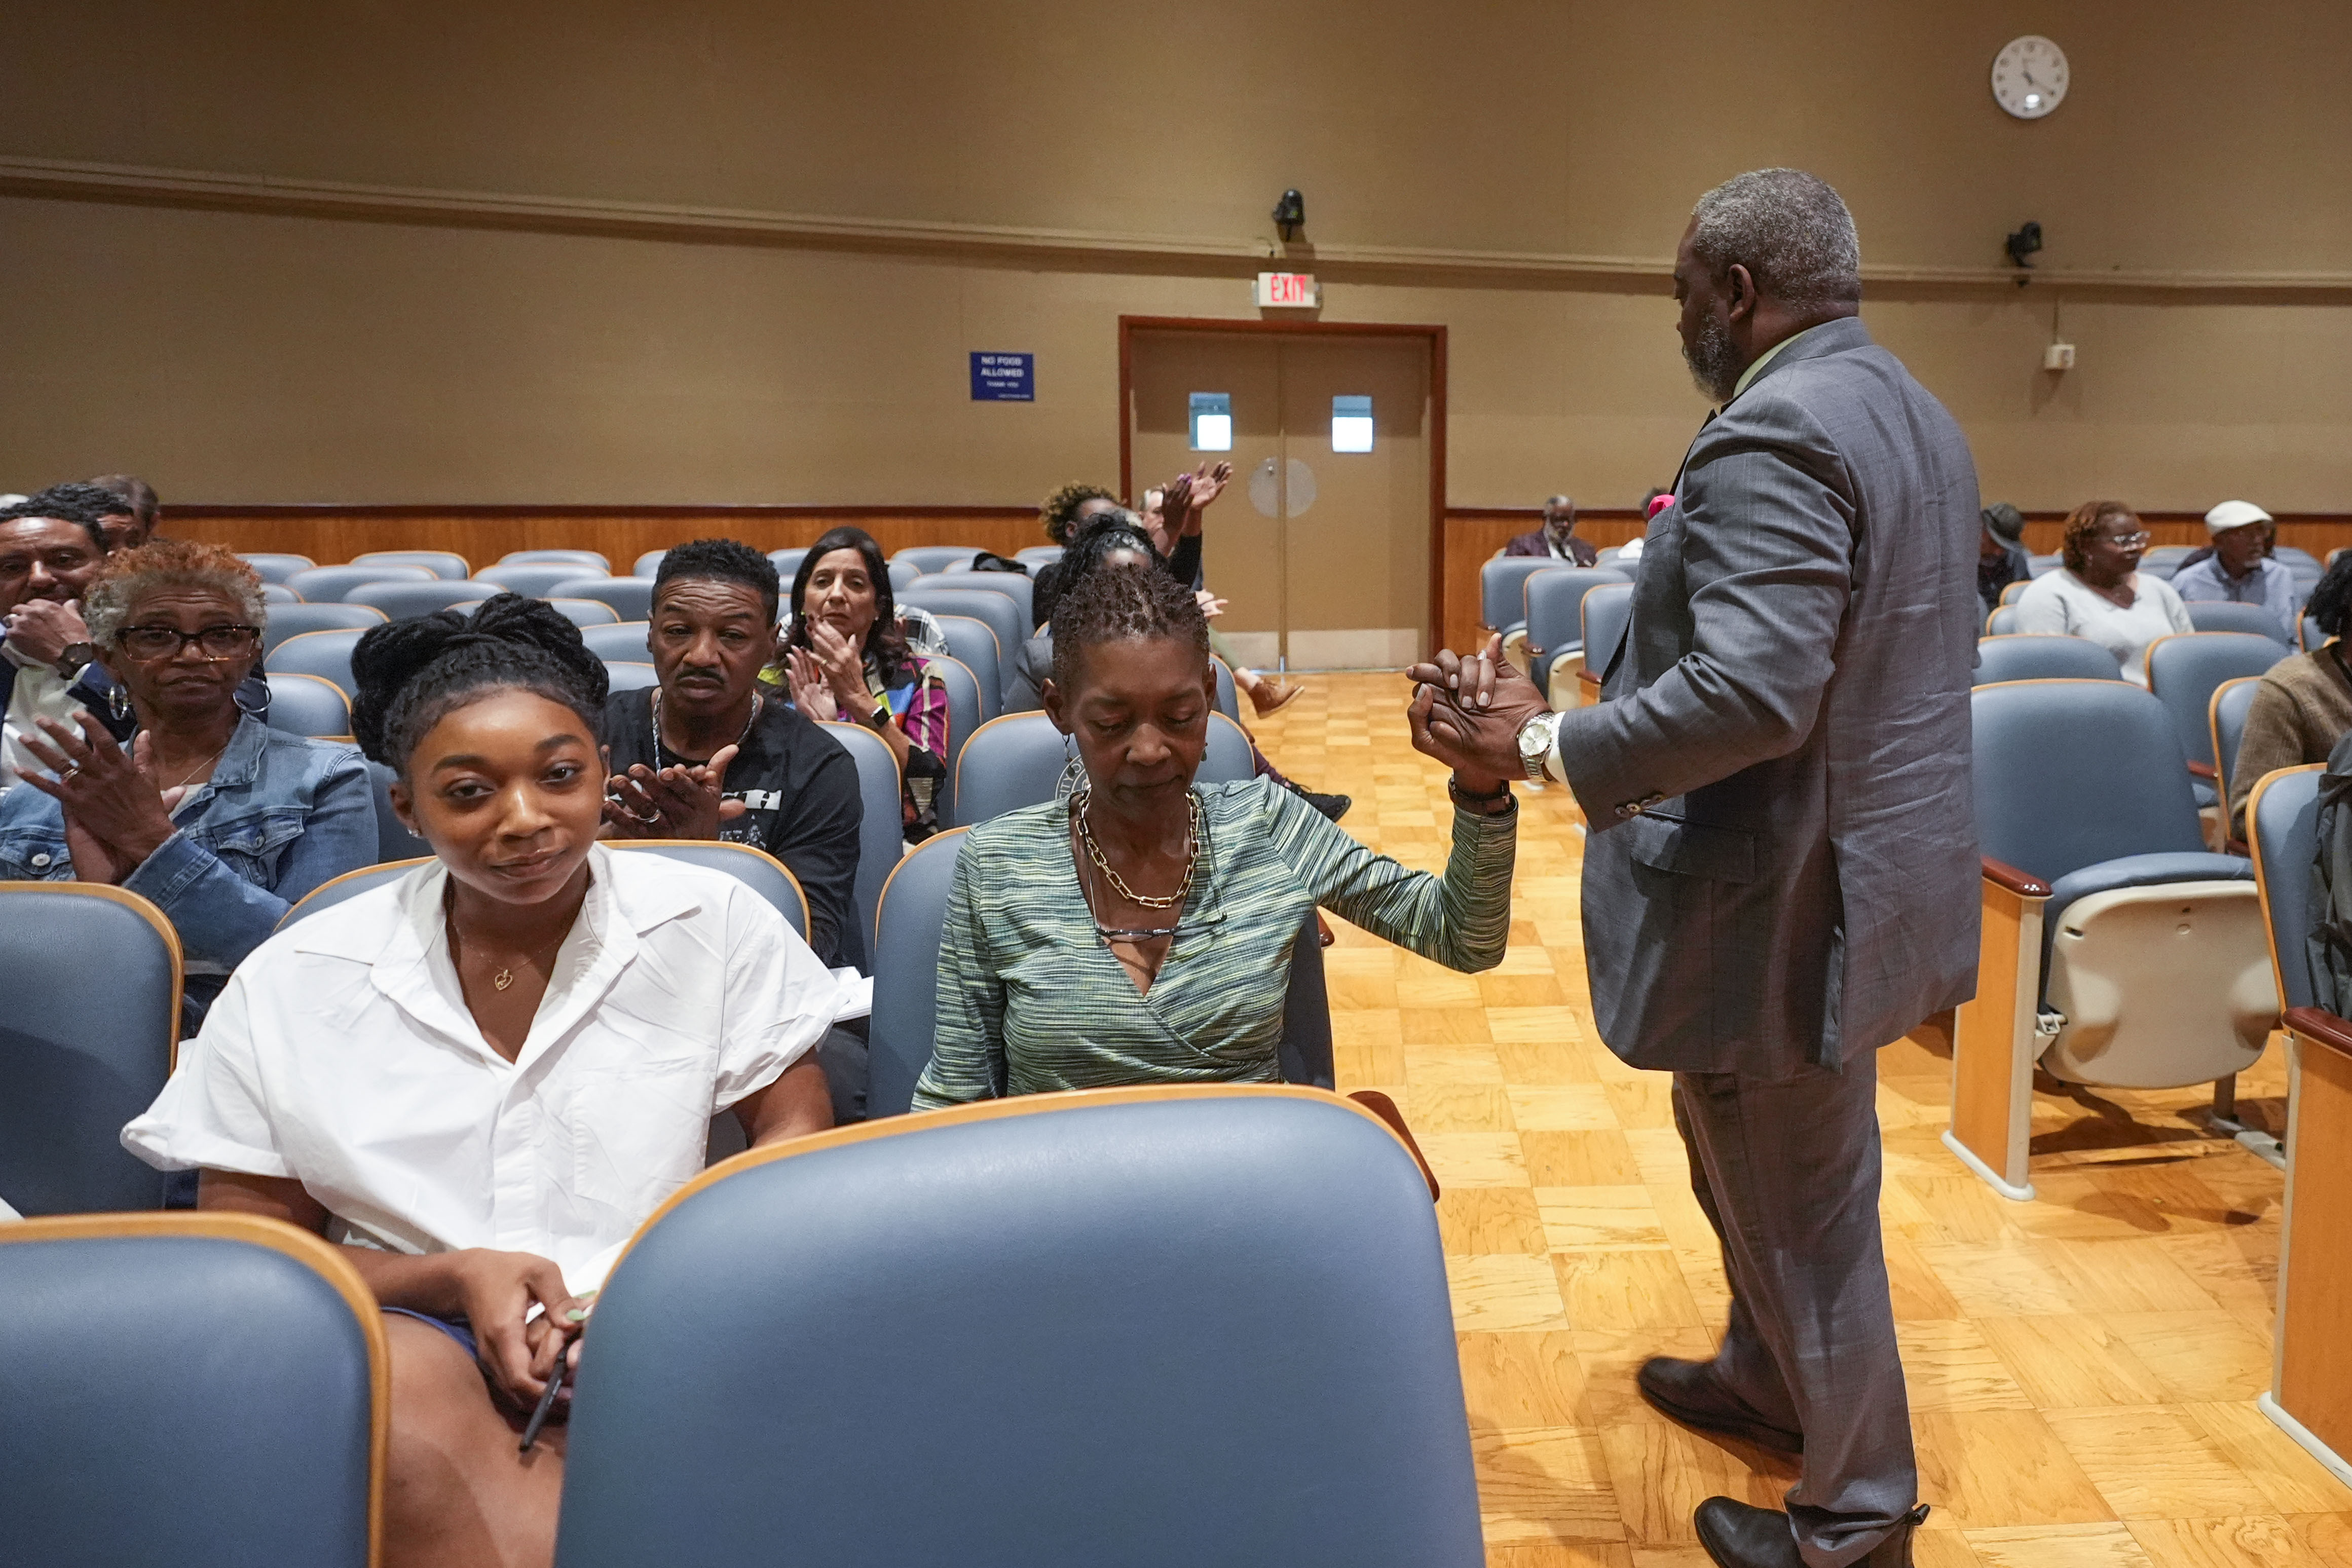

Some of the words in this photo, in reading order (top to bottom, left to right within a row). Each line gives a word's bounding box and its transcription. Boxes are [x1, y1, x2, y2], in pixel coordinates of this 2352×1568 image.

[1271, 275, 1307, 302] EXIT
[981, 356, 996, 365] NO
[997, 356, 1023, 366] FOOD
[981, 367, 1024, 378] ALLOWED
